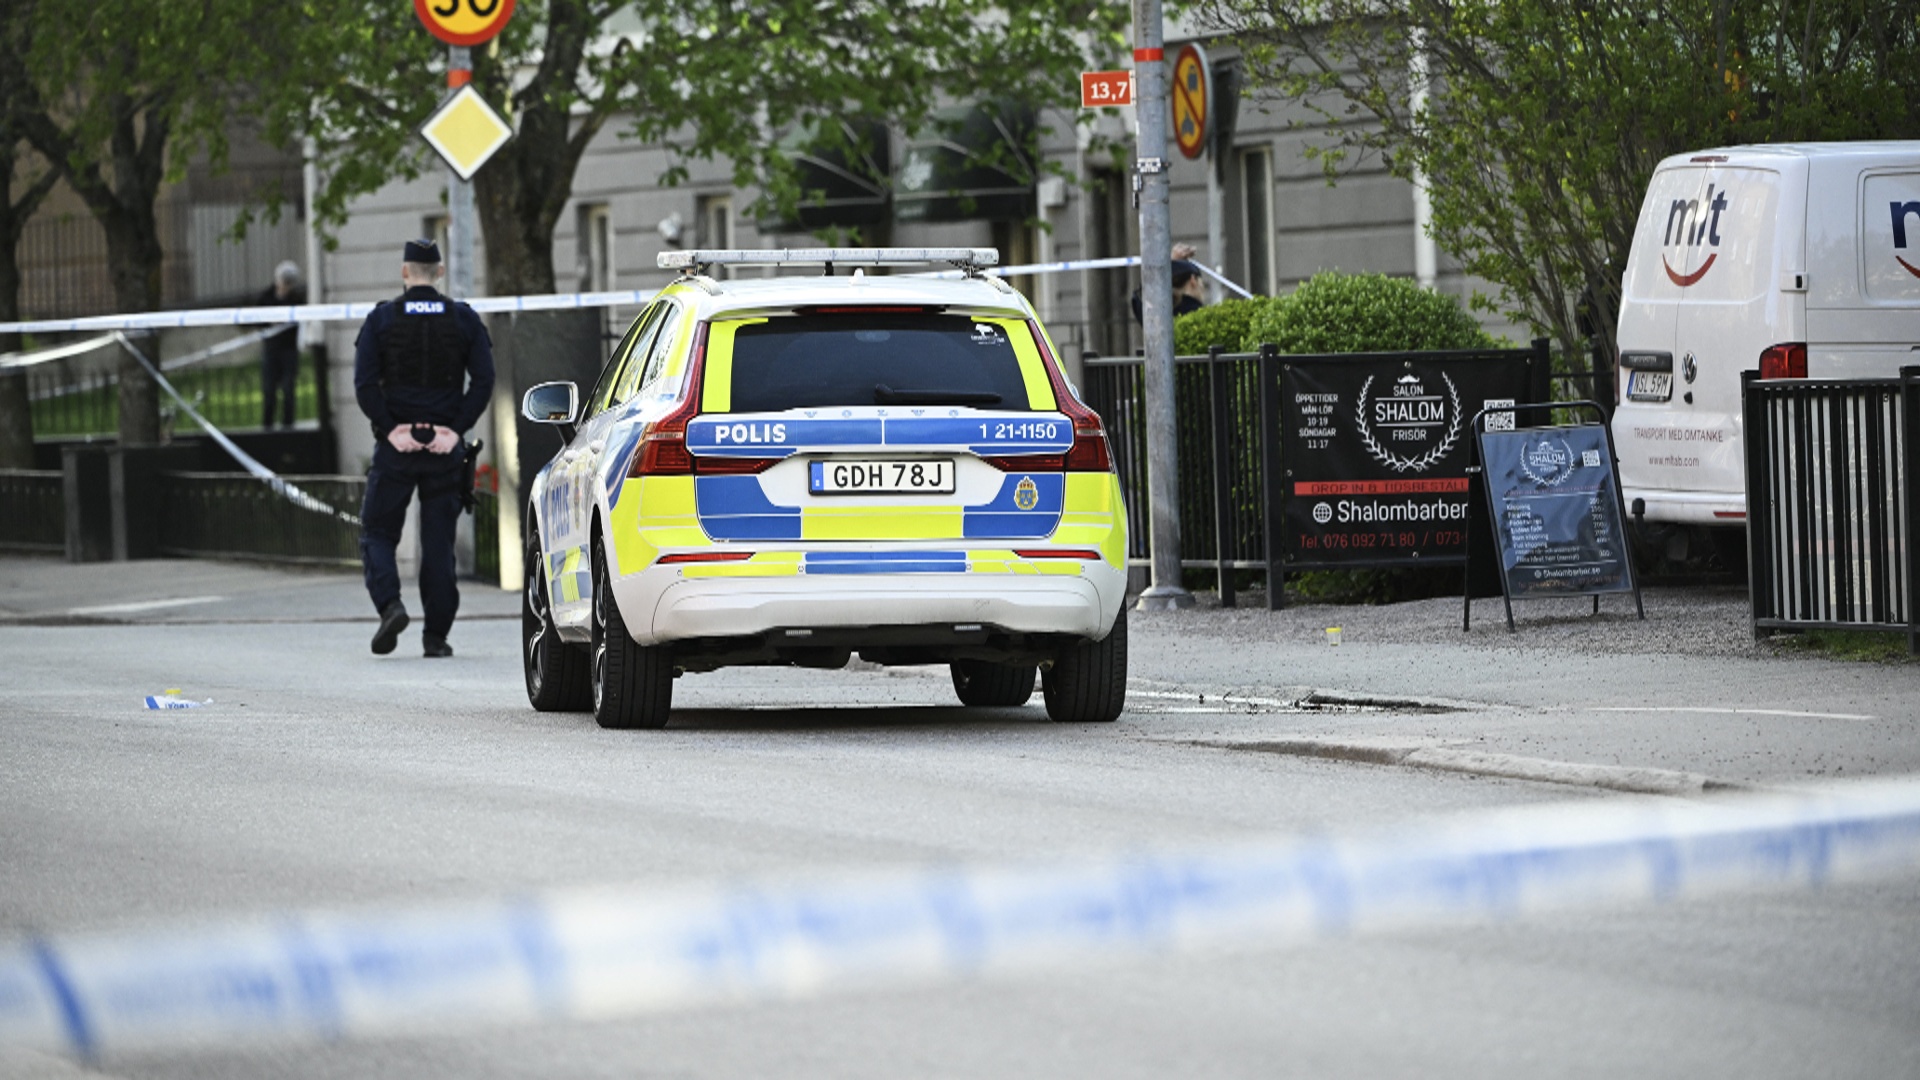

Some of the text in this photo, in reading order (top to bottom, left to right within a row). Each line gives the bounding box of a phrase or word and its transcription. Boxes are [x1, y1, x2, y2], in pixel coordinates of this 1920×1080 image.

[1090, 81, 1128, 101] 13,7
[1663, 183, 1728, 247] mlt
[405, 302, 444, 313] POLIS
[1393, 385, 1424, 397] SALON
[1633, 373, 1669, 395] NSL 59M
[1295, 393, 1339, 403] ÖPPETTIDER
[804, 408, 959, 418] VOLVO
[1375, 402, 1444, 421] SHALOM
[715, 423, 786, 444] POLIS
[979, 423, 1057, 439] 1 21-1150
[1299, 427, 1337, 438] SÖNDAGAR
[1392, 429, 1427, 441] FRISÖR
[1634, 427, 1724, 443] TRANSPORT MED OMTANKE
[833, 463, 942, 488] GDH 78J
[1311, 483, 1348, 494] DROP
[1351, 483, 1364, 493] IN
[1337, 498, 1468, 523] Shalombarber
[1324, 533, 1348, 548] 076
[1352, 533, 1376, 547] 092
[1380, 533, 1396, 546] 71
[1399, 532, 1415, 547] 80
